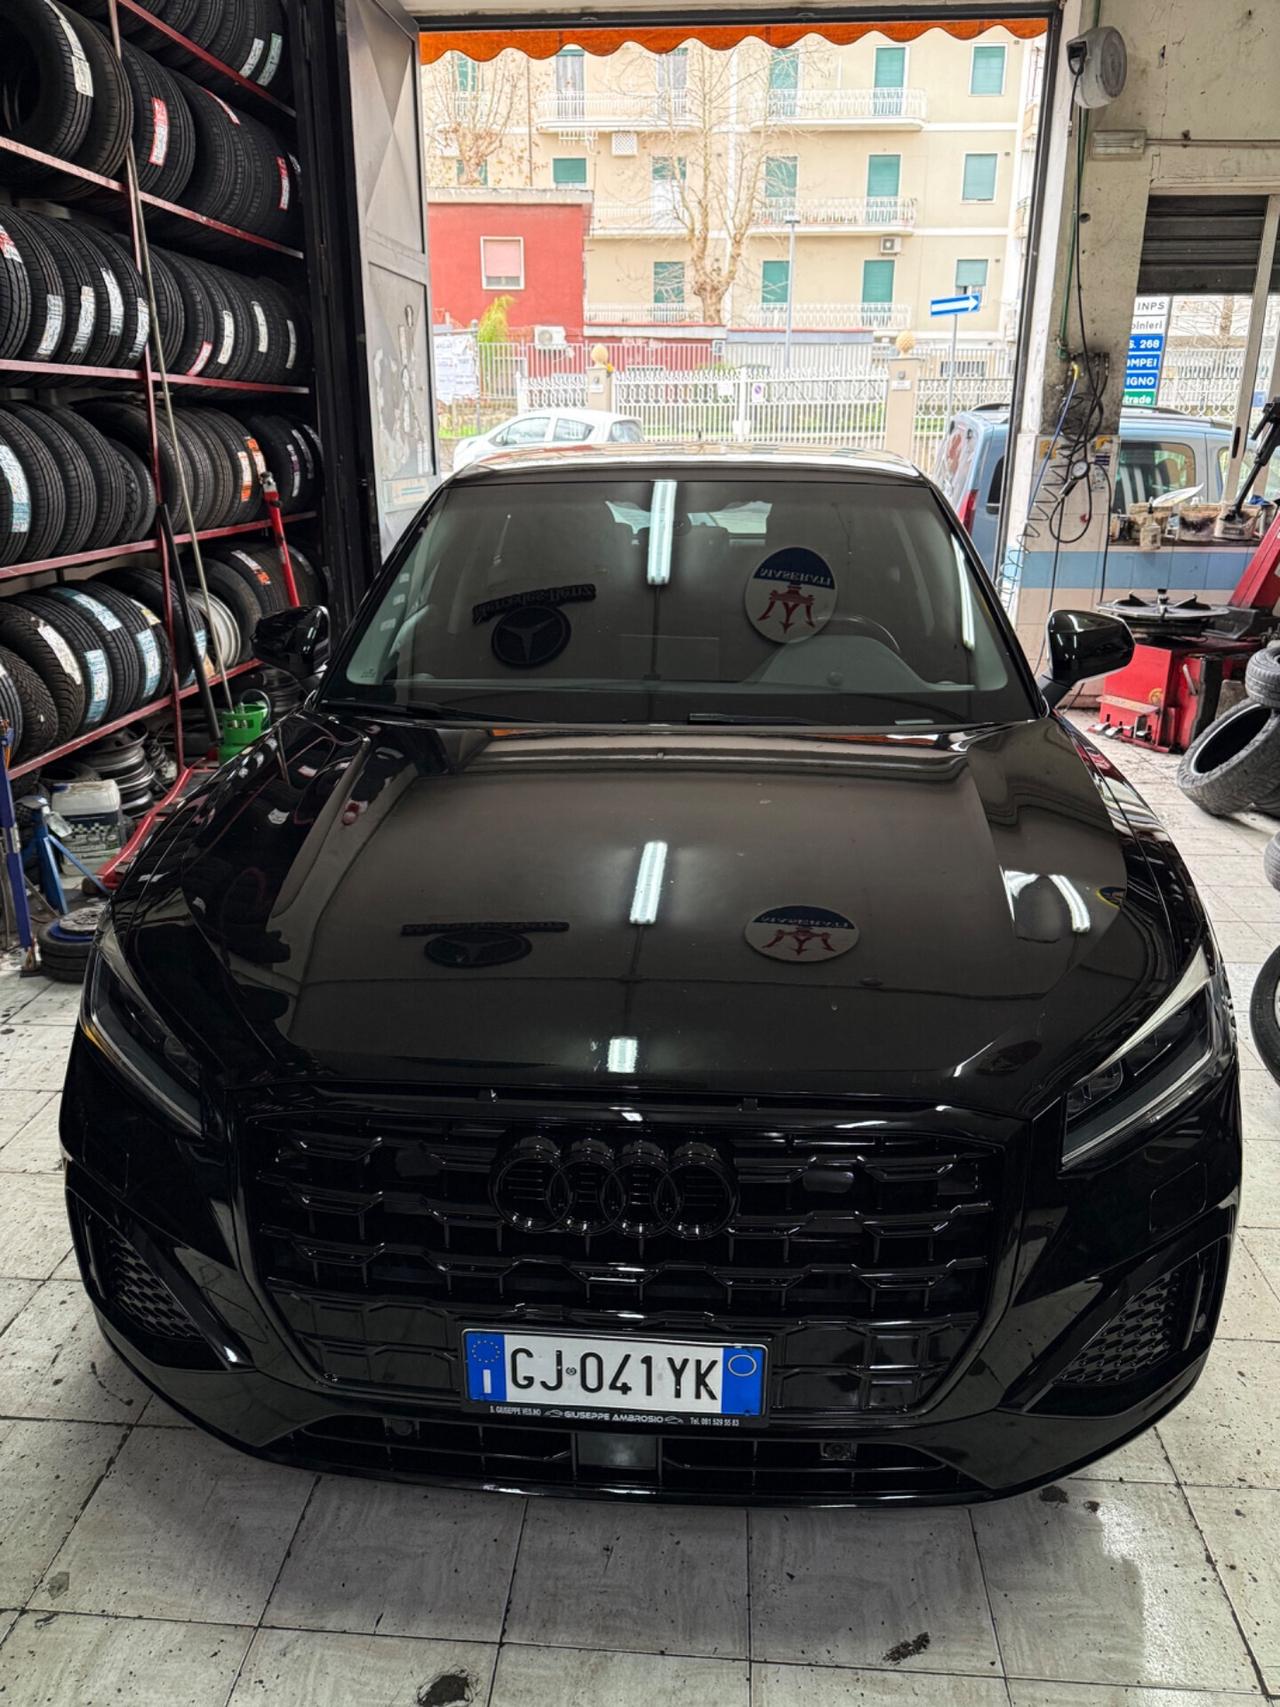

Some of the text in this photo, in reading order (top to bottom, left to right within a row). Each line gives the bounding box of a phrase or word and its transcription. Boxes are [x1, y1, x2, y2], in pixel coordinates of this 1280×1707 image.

[1136, 301, 1165, 310] INPS
[1139, 339, 1160, 349] 268
[564, 1410, 664, 1424] GIUSEPPE AMBROSIO
